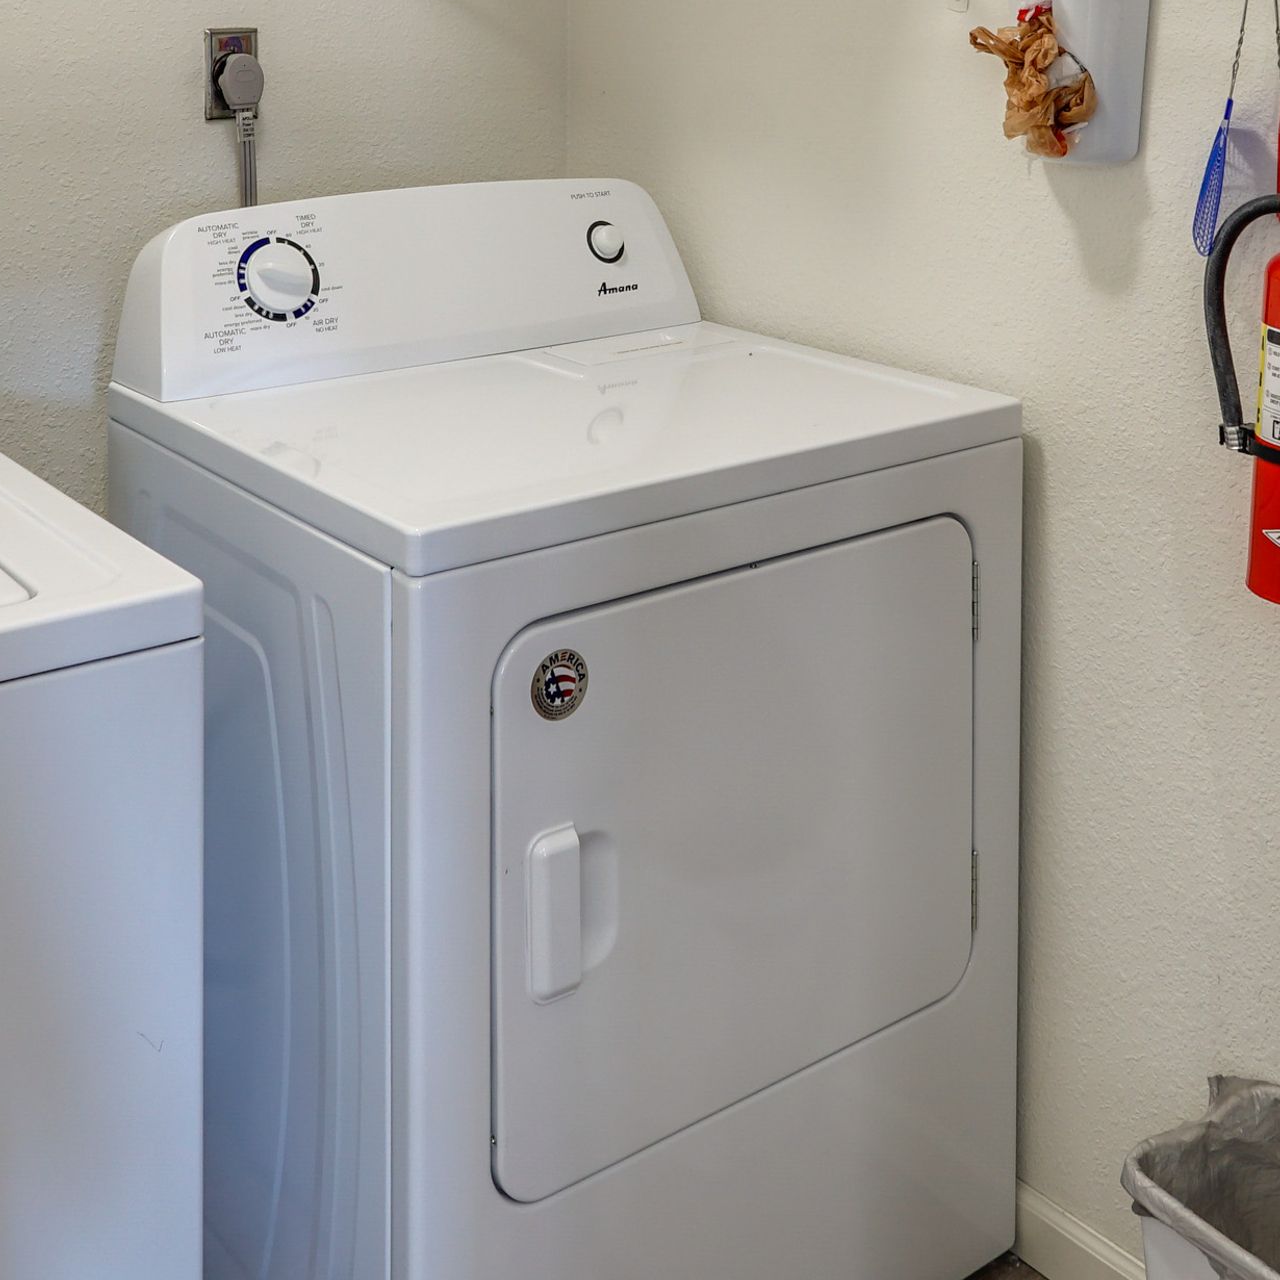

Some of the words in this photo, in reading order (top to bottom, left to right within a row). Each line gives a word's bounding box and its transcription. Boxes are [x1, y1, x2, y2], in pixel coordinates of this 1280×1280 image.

[198, 223, 239, 233] AUTOMATIC
[598, 282, 638, 296] Amana
[325, 317, 339, 325] DRY
[204, 328, 246, 339] AUTOMATIC
[541, 652, 586, 682] AMERICA
